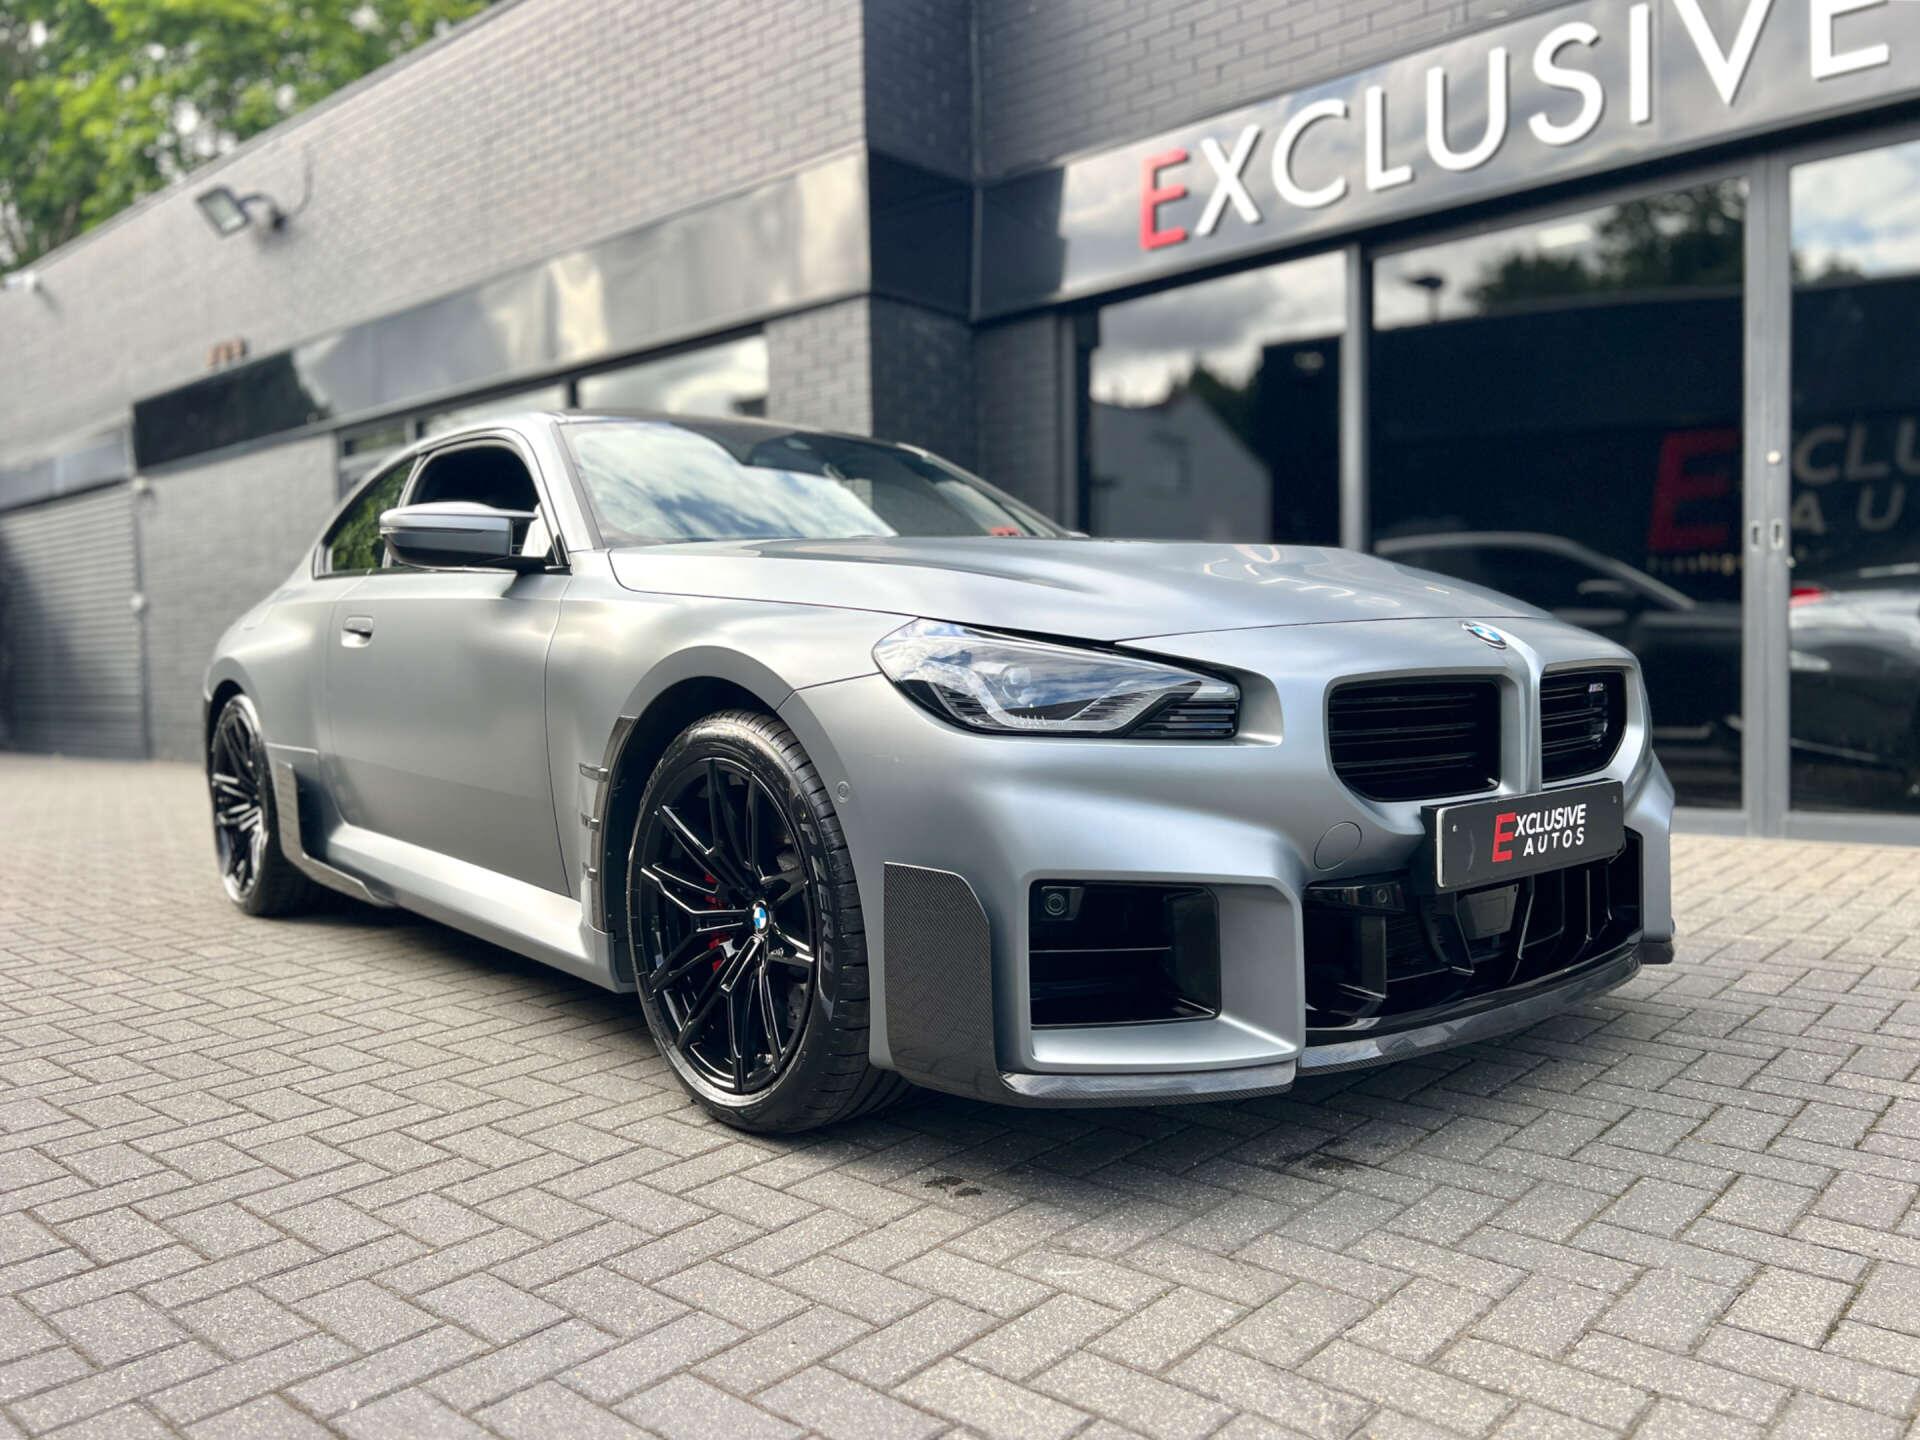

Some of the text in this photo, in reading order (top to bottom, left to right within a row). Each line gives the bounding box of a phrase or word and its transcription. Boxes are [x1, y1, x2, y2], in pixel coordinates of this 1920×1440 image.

[1139, 0, 1890, 250] EXCLUSIVE
[1491, 803, 1587, 863] EXCLUSIVE
[1523, 826, 1585, 857] AUTOS
